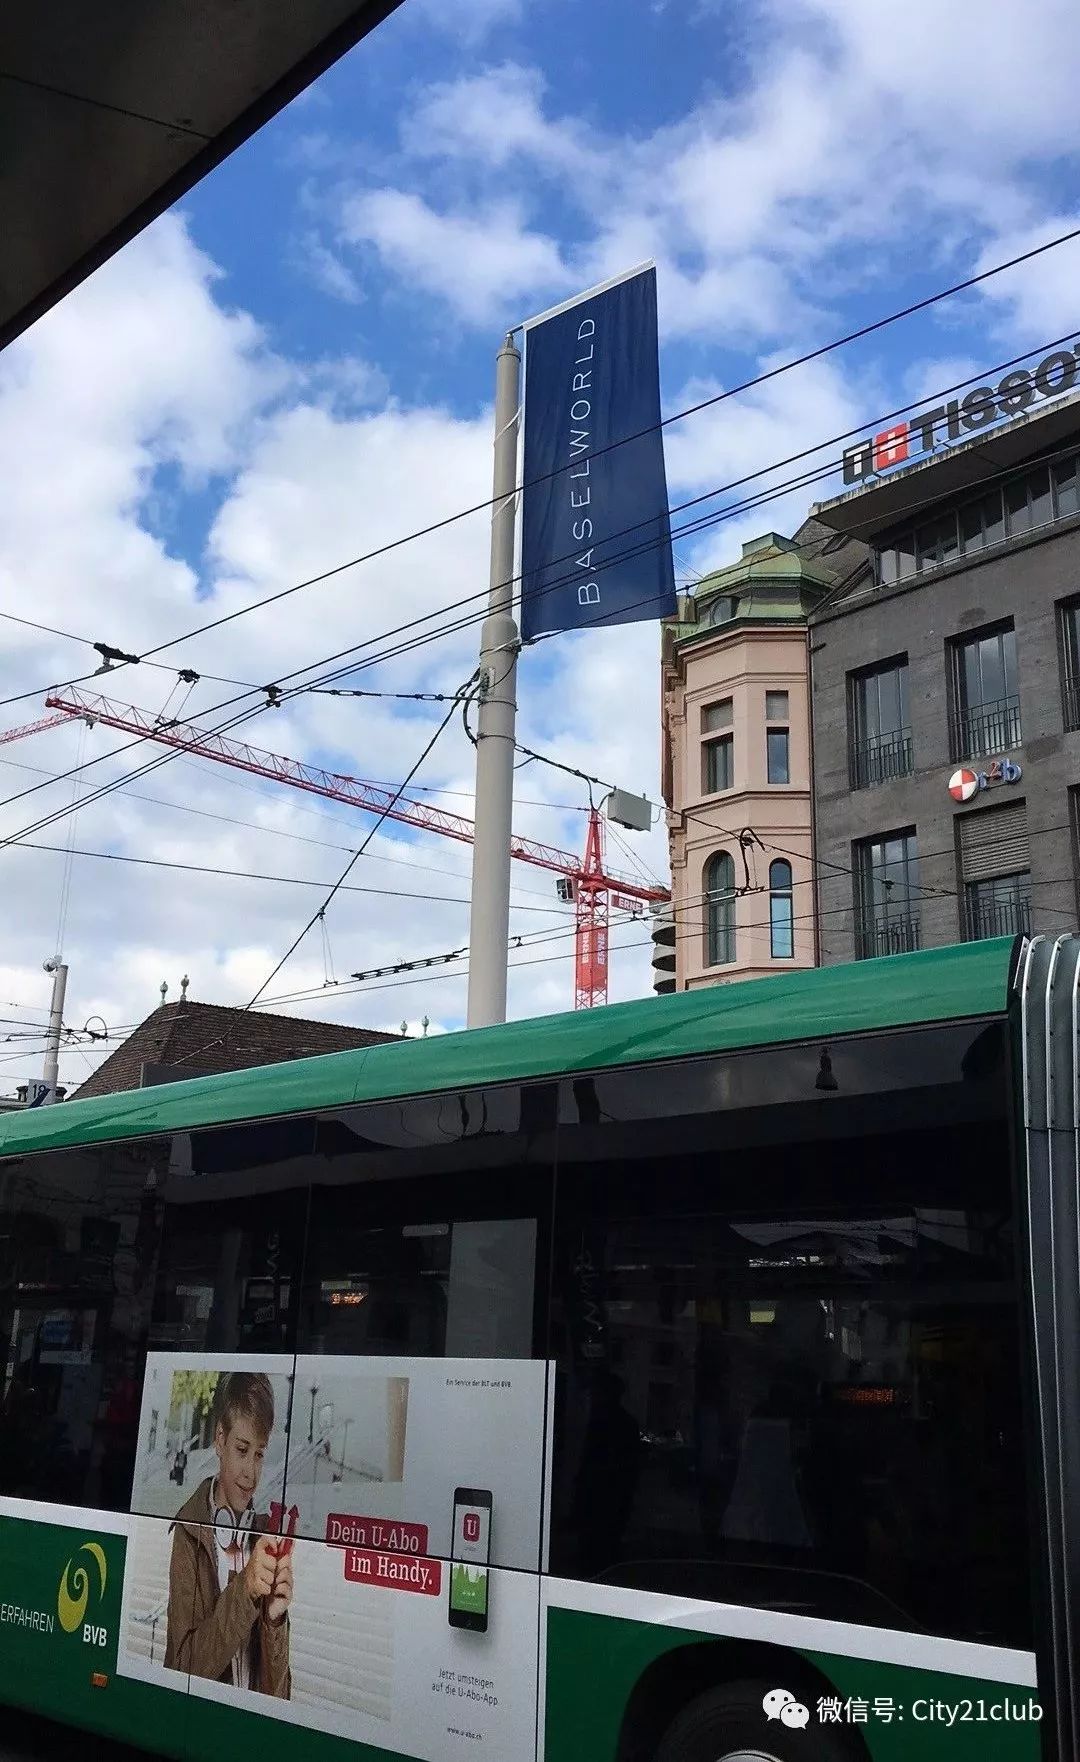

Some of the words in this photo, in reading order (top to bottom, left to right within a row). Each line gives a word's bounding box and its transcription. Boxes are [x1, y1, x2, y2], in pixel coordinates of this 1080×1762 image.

[910, 343, 1080, 450] TISSO
[568, 318, 601, 606] BASELWORLD
[331, 1520, 366, 1545] Dein
[372, 1523, 419, 1551] U-Abo
[466, 1519, 477, 1536] U
[351, 1550, 371, 1575] im
[377, 1555, 433, 1591] Handy.
[0, 1603, 54, 1634] ERFAHREN
[83, 1623, 107, 1647] BVB
[432, 1682, 444, 1692] auf
[445, 1685, 456, 1696] die
[458, 1687, 498, 1706] U-Abo-App
[439, 1668, 455, 1681] Jetzt
[457, 1675, 494, 1690] umsteigen
